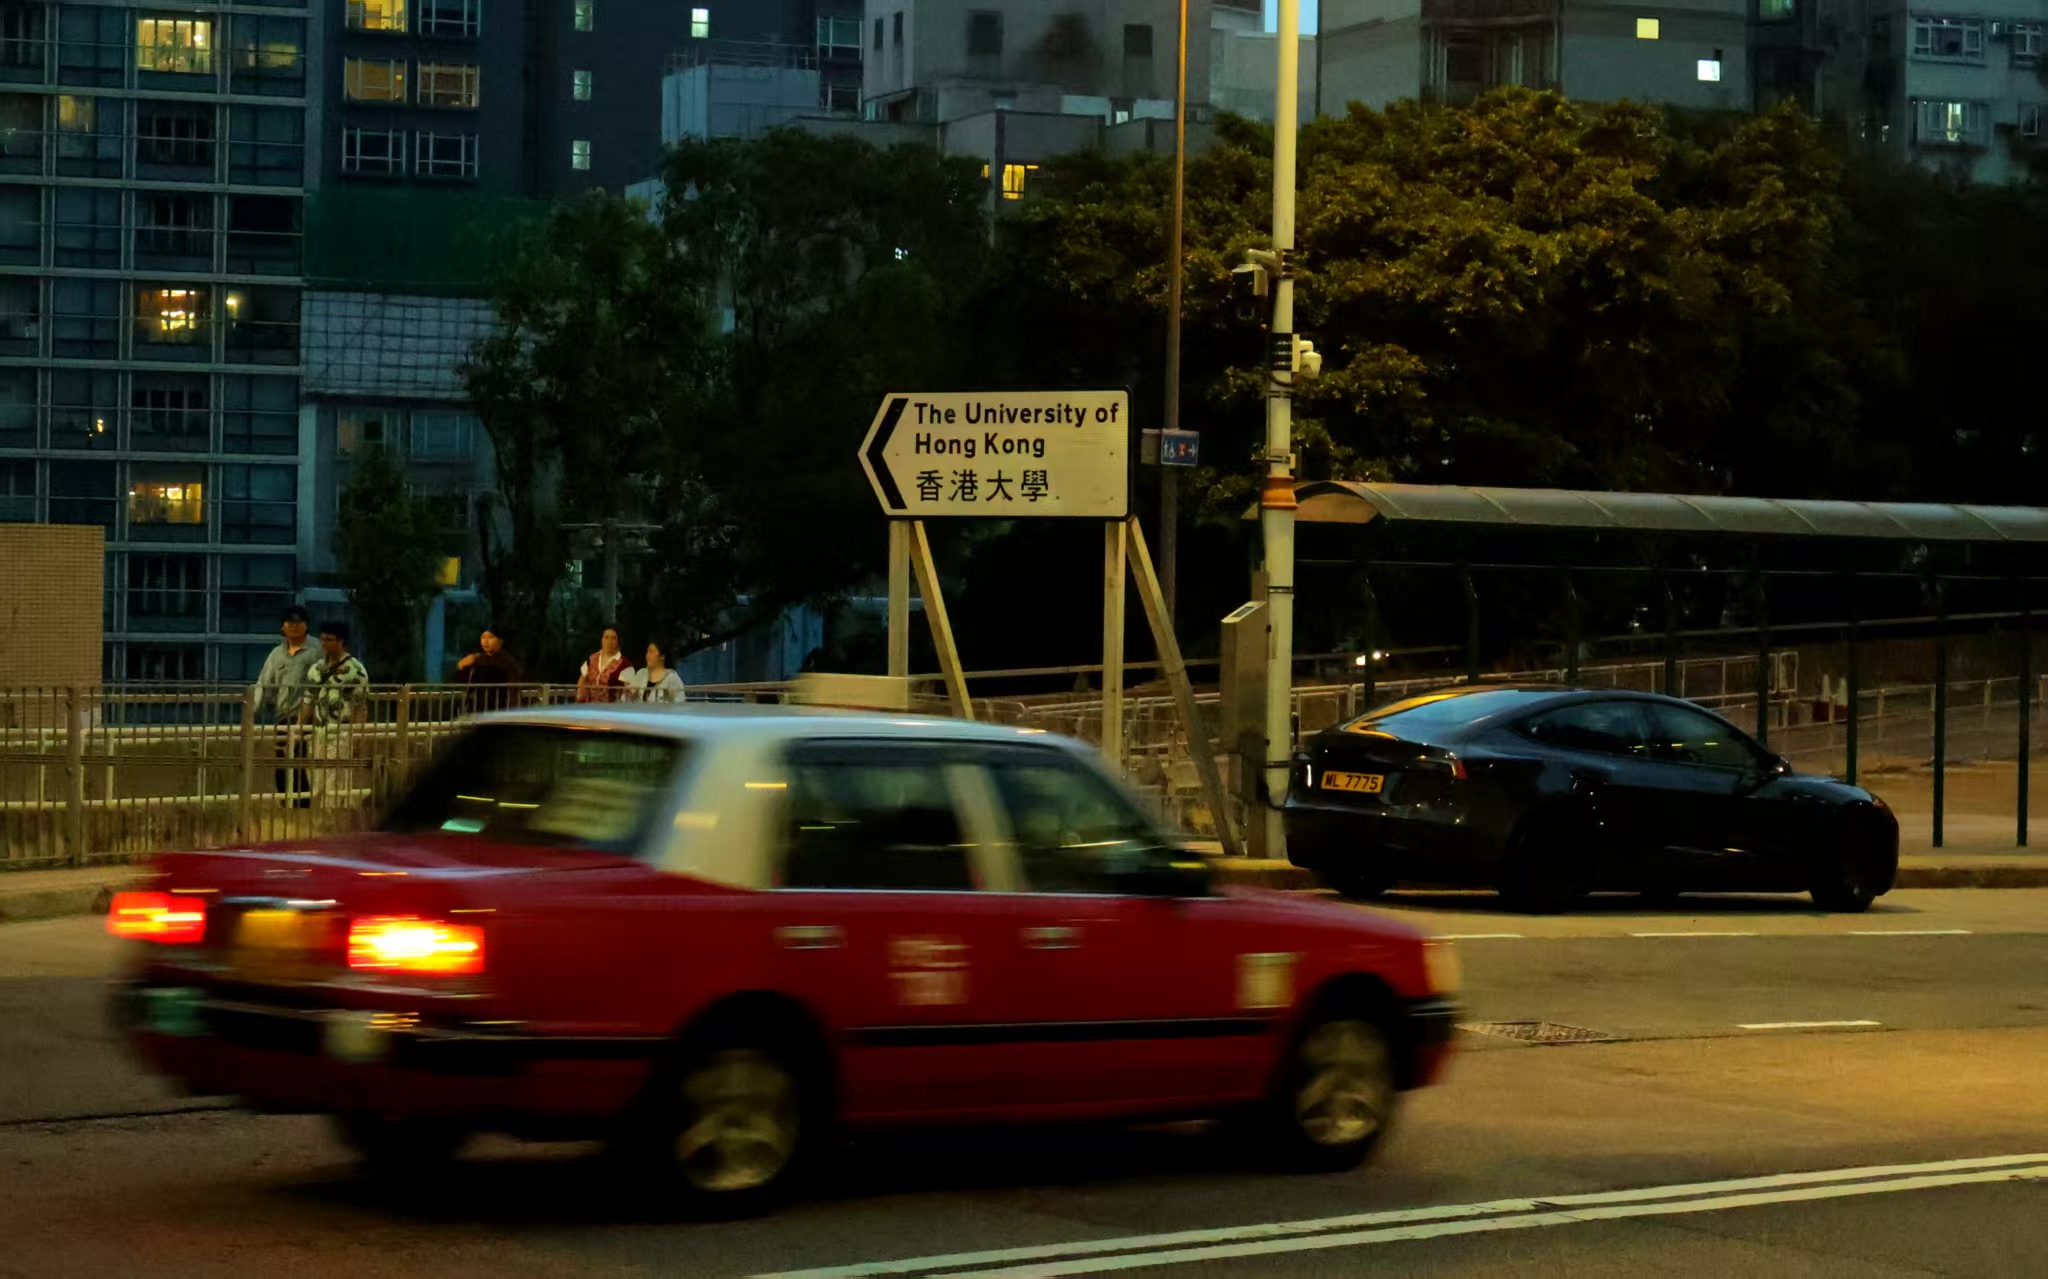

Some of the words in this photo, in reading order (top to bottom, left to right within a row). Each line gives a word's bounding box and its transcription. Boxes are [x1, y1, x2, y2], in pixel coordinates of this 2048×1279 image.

[914, 403, 956, 424] The
[965, 402, 1087, 428] University
[1095, 402, 1119, 423] of
[915, 433, 976, 458] Hong
[984, 433, 1045, 458] Kong
[916, 469, 1049, 502] 香港大學
[1345, 774, 1379, 790] 7775
